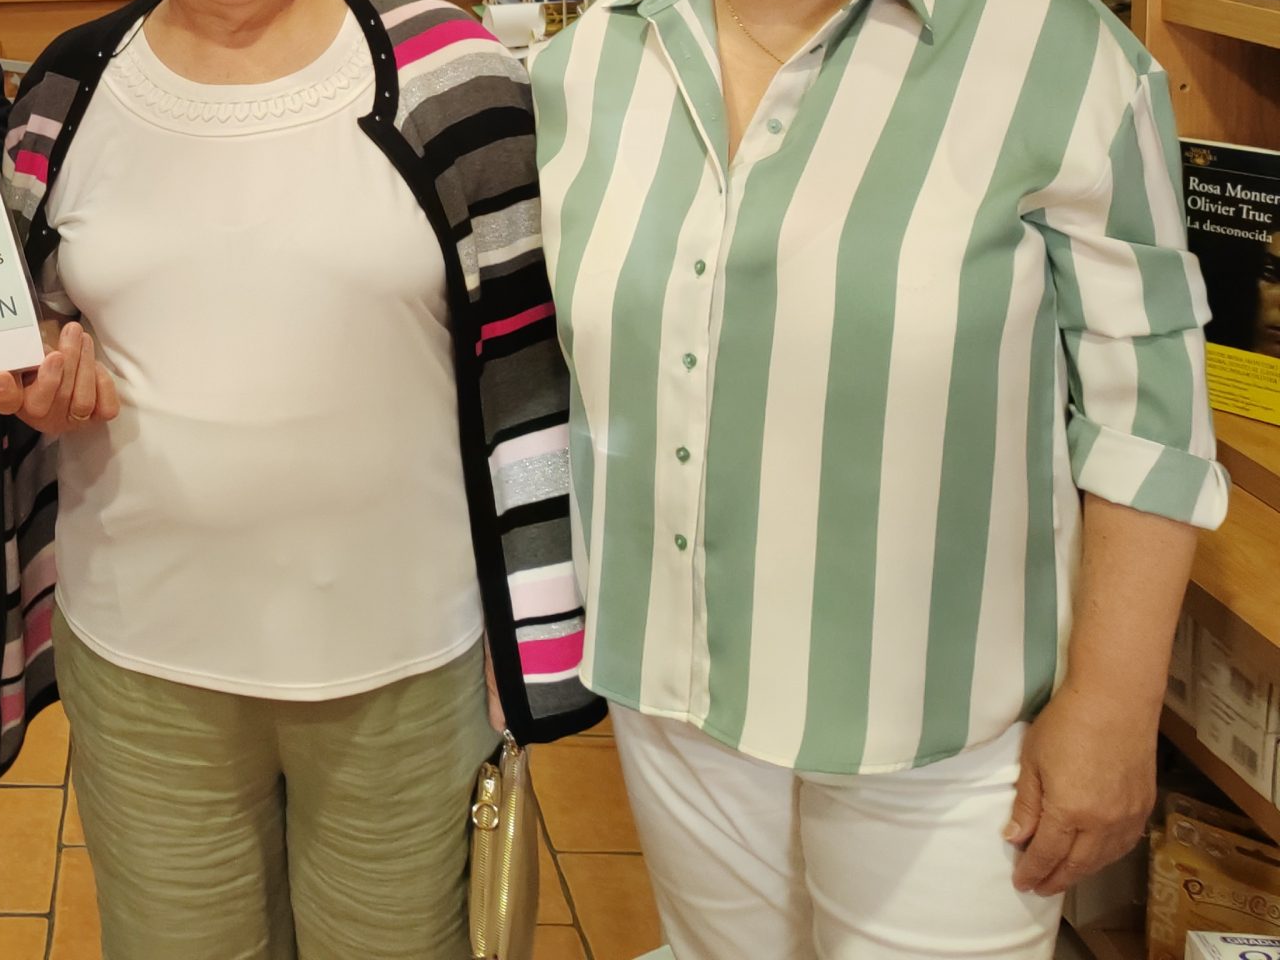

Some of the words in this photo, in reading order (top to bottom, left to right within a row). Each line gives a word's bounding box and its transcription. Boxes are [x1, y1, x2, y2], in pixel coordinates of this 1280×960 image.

[1189, 176, 1221, 195] Rosa
[1225, 182, 1280, 205] Monter
[1187, 195, 1236, 216] Olivier
[1238, 203, 1273, 223] Truc
[1187, 215, 1200, 229] La
[1202, 219, 1273, 243] desconocida
